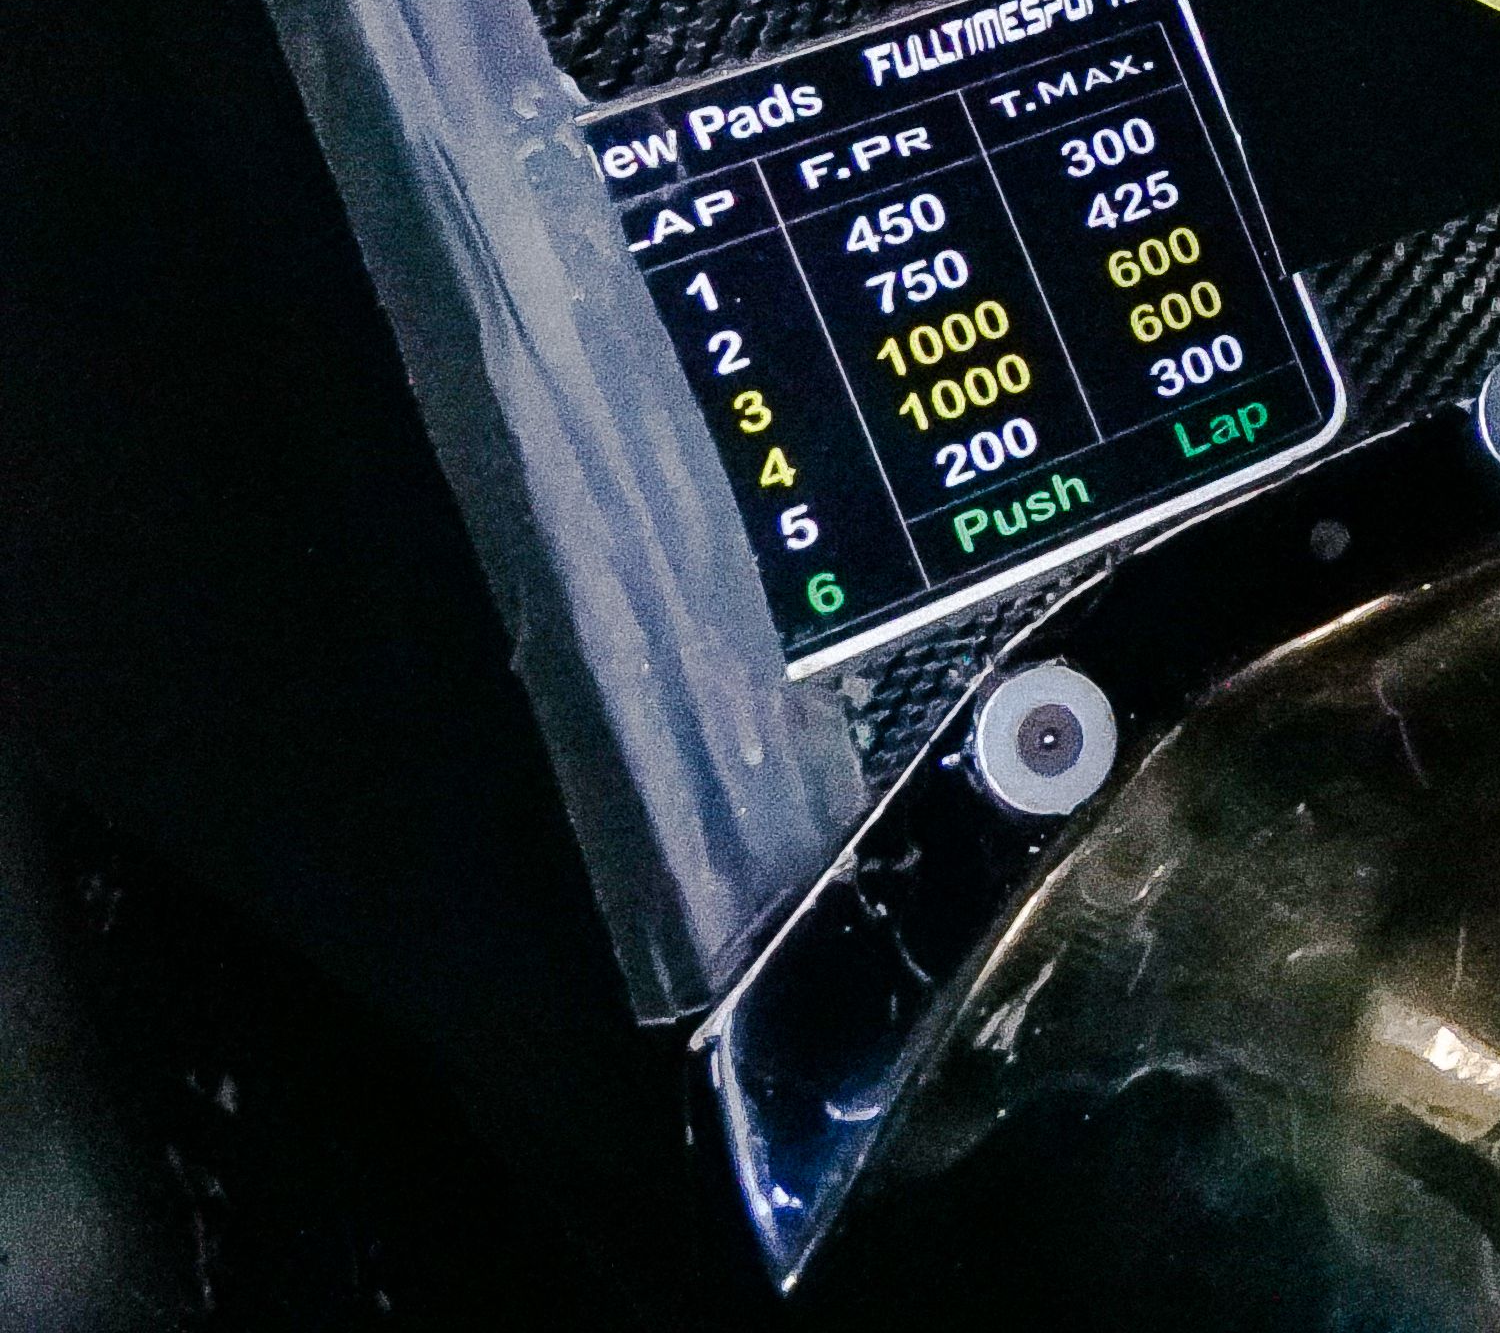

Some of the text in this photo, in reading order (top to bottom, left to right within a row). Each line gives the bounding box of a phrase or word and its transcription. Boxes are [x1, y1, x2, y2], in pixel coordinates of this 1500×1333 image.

[596, 82, 824, 180] ew Pads
[685, 116, 1158, 312] 1 450 300
[798, 125, 932, 190] F.PR
[706, 170, 1181, 376] 2 750 425
[733, 226, 1203, 433] 3 1000 600
[759, 281, 1223, 489] 4 1000 600
[779, 334, 1244, 551] 5 200 300
[806, 400, 1269, 615] 6 Push Lap
